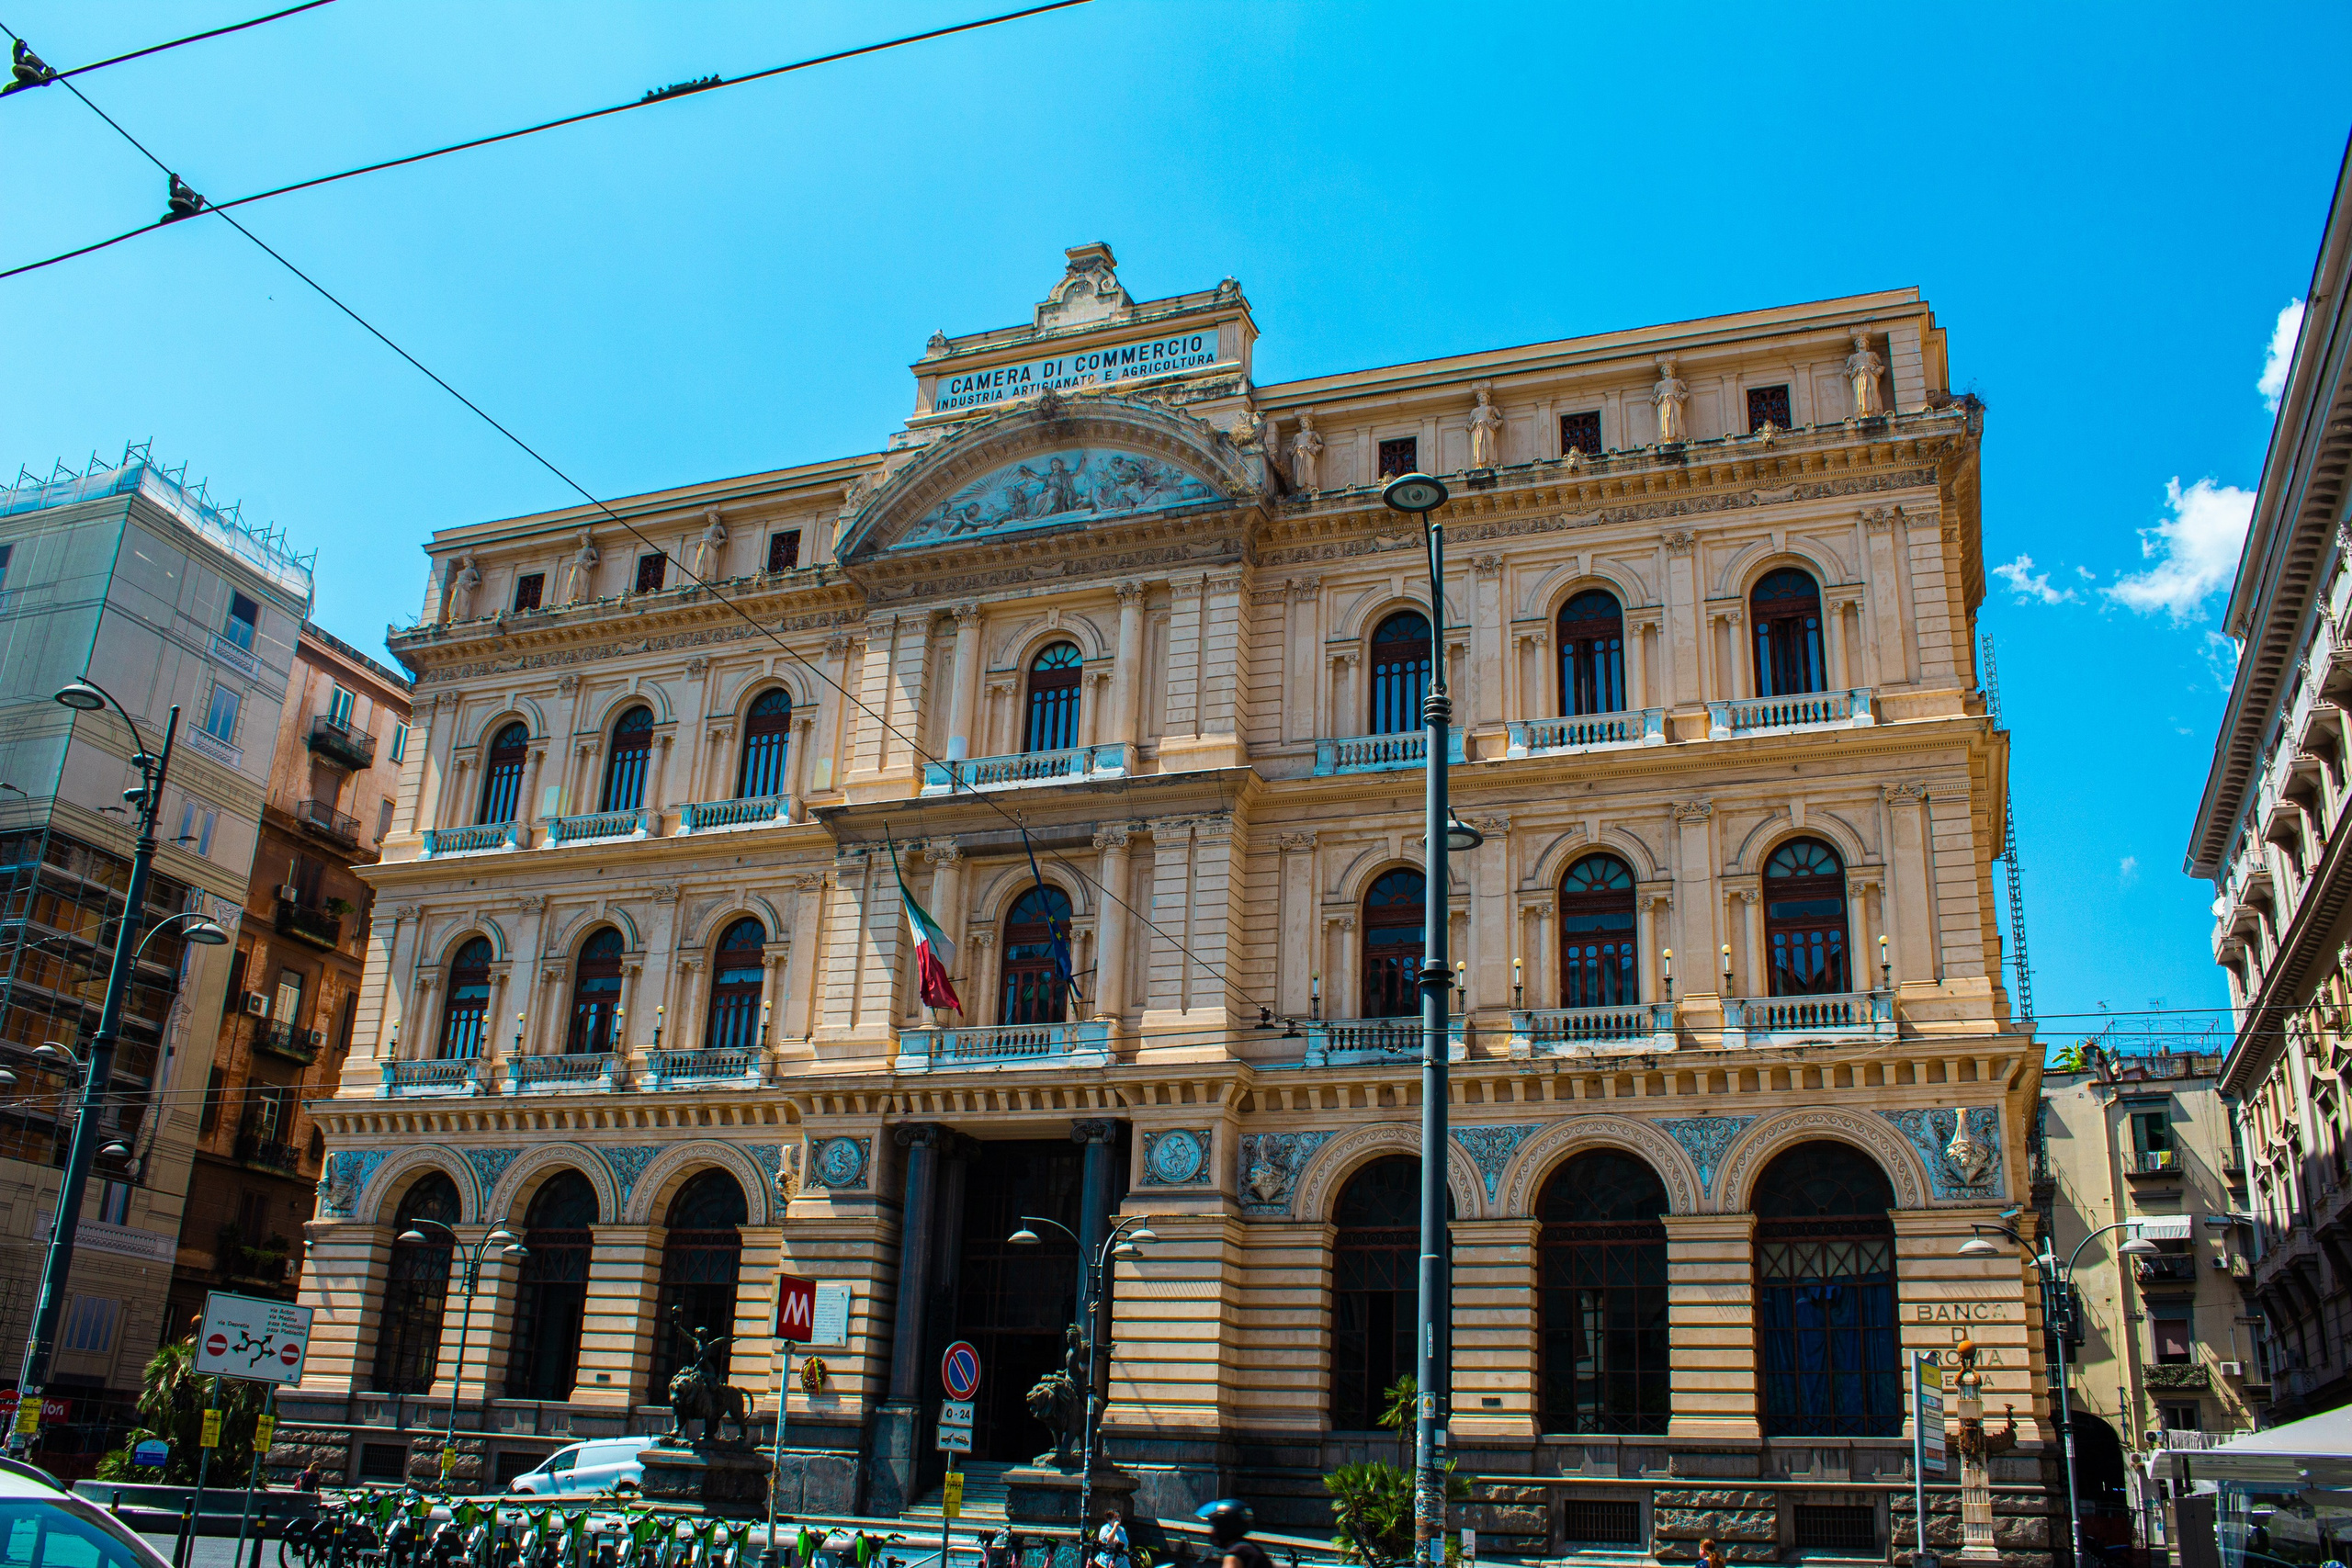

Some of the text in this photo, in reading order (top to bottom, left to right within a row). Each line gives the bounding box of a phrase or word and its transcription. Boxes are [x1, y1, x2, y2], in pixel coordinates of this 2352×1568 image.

[936, 353, 1215, 411] INDUSTRIA ARTIGIANATO E AGRICOLTURA
[950, 335, 1203, 395] CAMERA DI COMMERCIO
[782, 1291, 810, 1328] M
[1917, 1303, 2007, 1321] BANCA
[959, 1408, 970, 1419] 24
